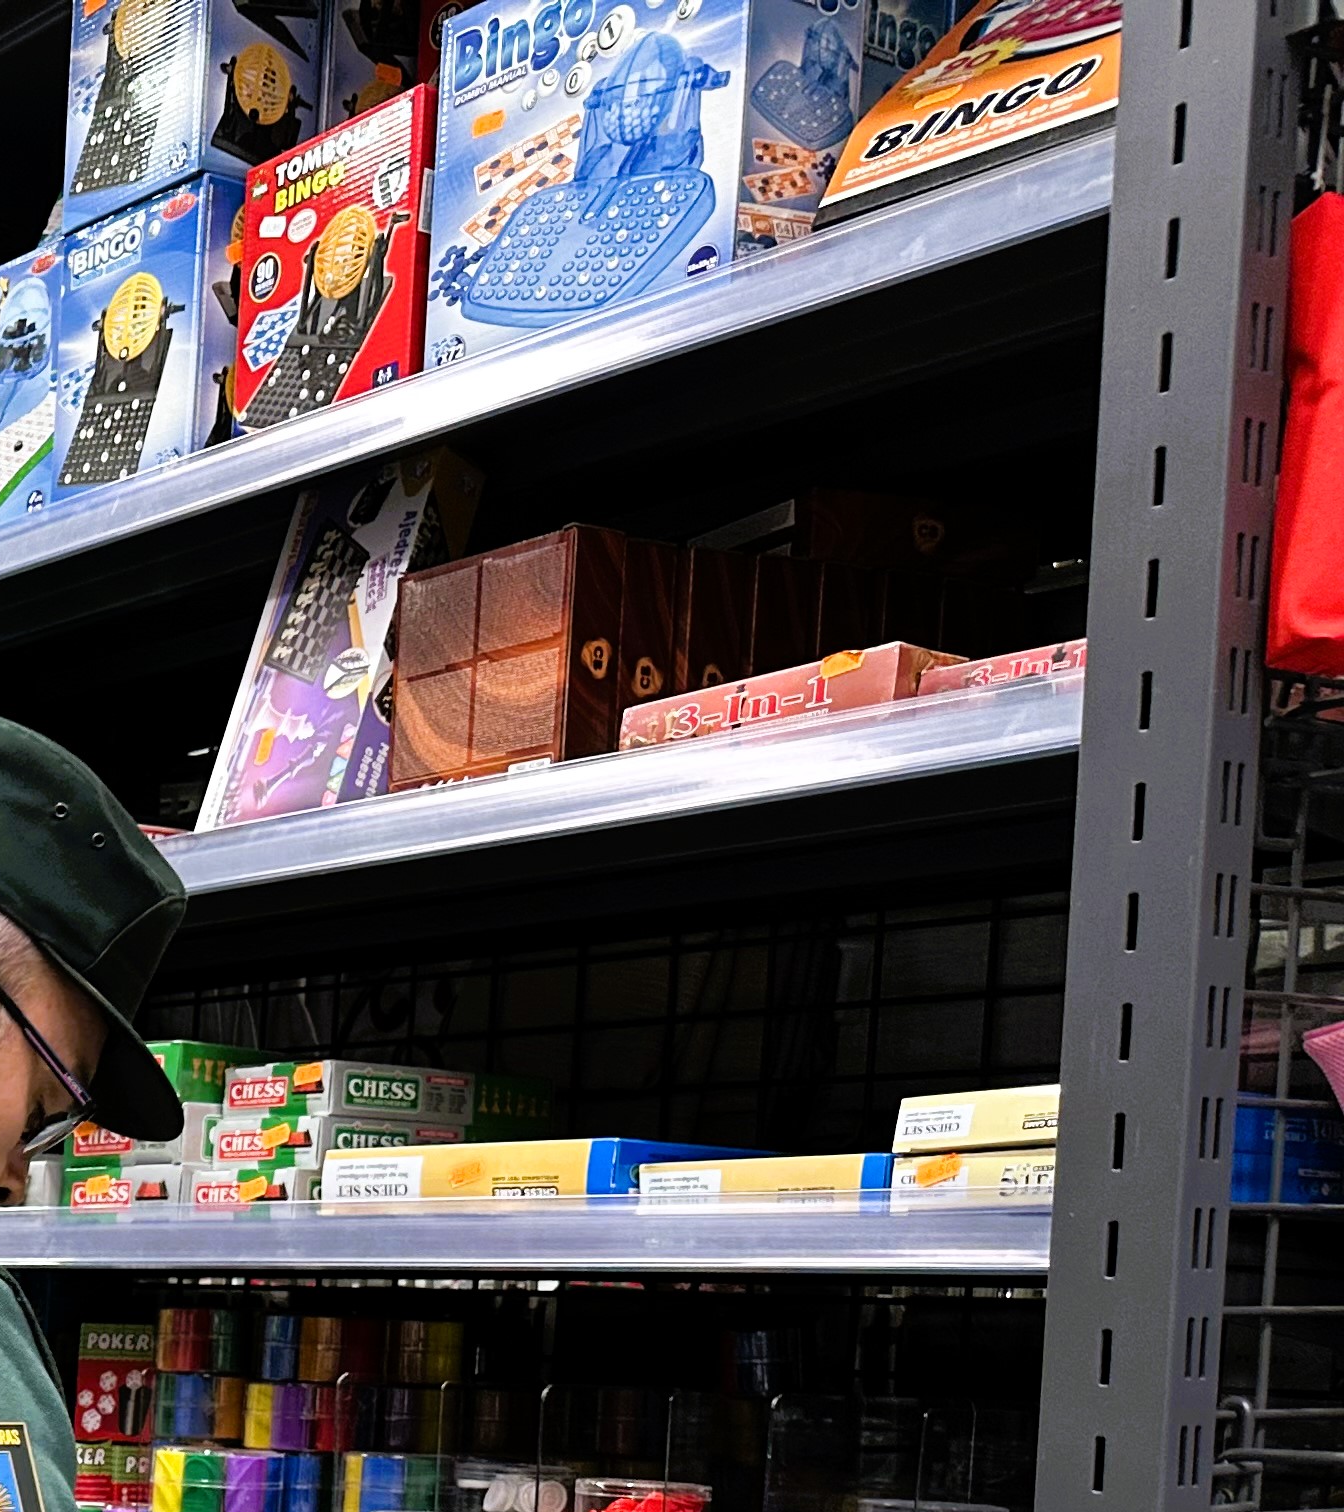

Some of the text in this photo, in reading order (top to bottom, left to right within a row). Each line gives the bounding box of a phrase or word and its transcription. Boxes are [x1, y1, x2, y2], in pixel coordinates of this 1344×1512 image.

[453, 0, 595, 95] Bingo
[487, 66, 528, 91] MANUAL
[863, 54, 1103, 162] BINGO
[274, 160, 346, 214] BINGO
[70, 225, 143, 274] BINGO
[386, 510, 418, 577] Ajedrez
[231, 1081, 285, 1101] CHESS
[348, 1078, 416, 1101] CHESS
[336, 1132, 406, 1149] CHESS
[902, 1121, 960, 1137] CHESS SET
[197, 1187, 240, 1204] CHES
[336, 1183, 408, 1198] CHESS SET
[87, 1333, 150, 1350] POKER
